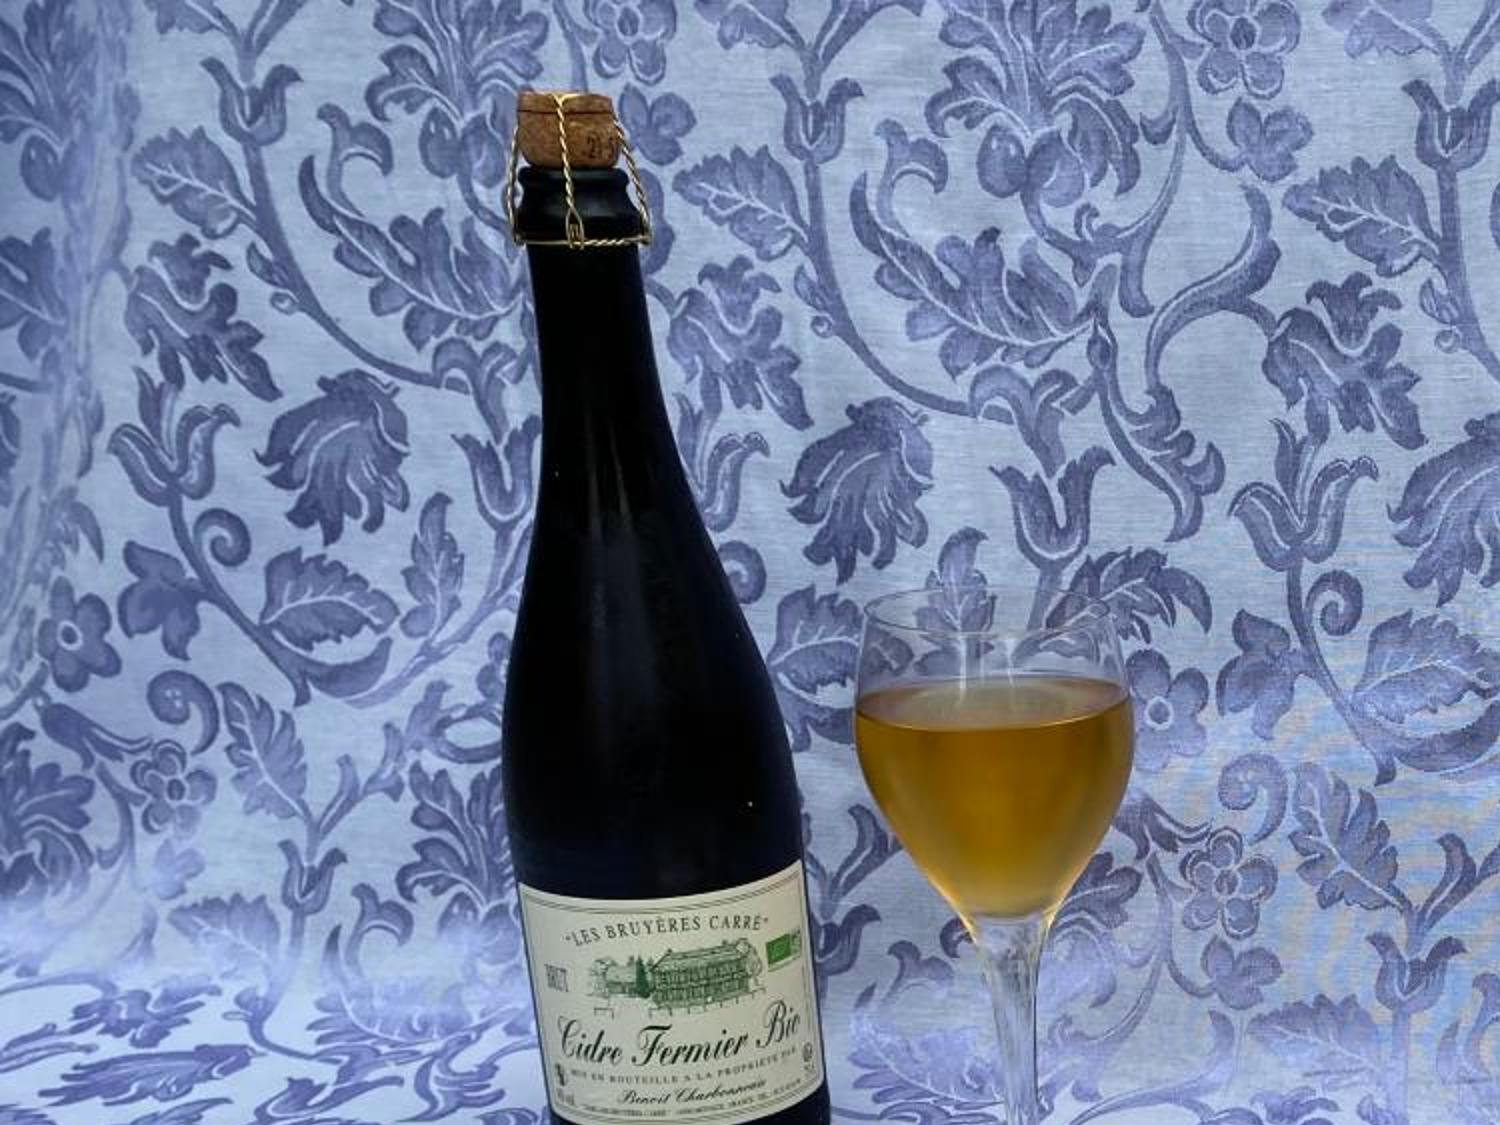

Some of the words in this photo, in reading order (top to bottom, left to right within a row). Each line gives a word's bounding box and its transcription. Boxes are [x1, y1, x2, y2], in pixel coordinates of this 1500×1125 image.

[557, 1015, 624, 1066] Cidre
[631, 1024, 749, 1067] Fermier
[756, 1000, 800, 1049] Bio
